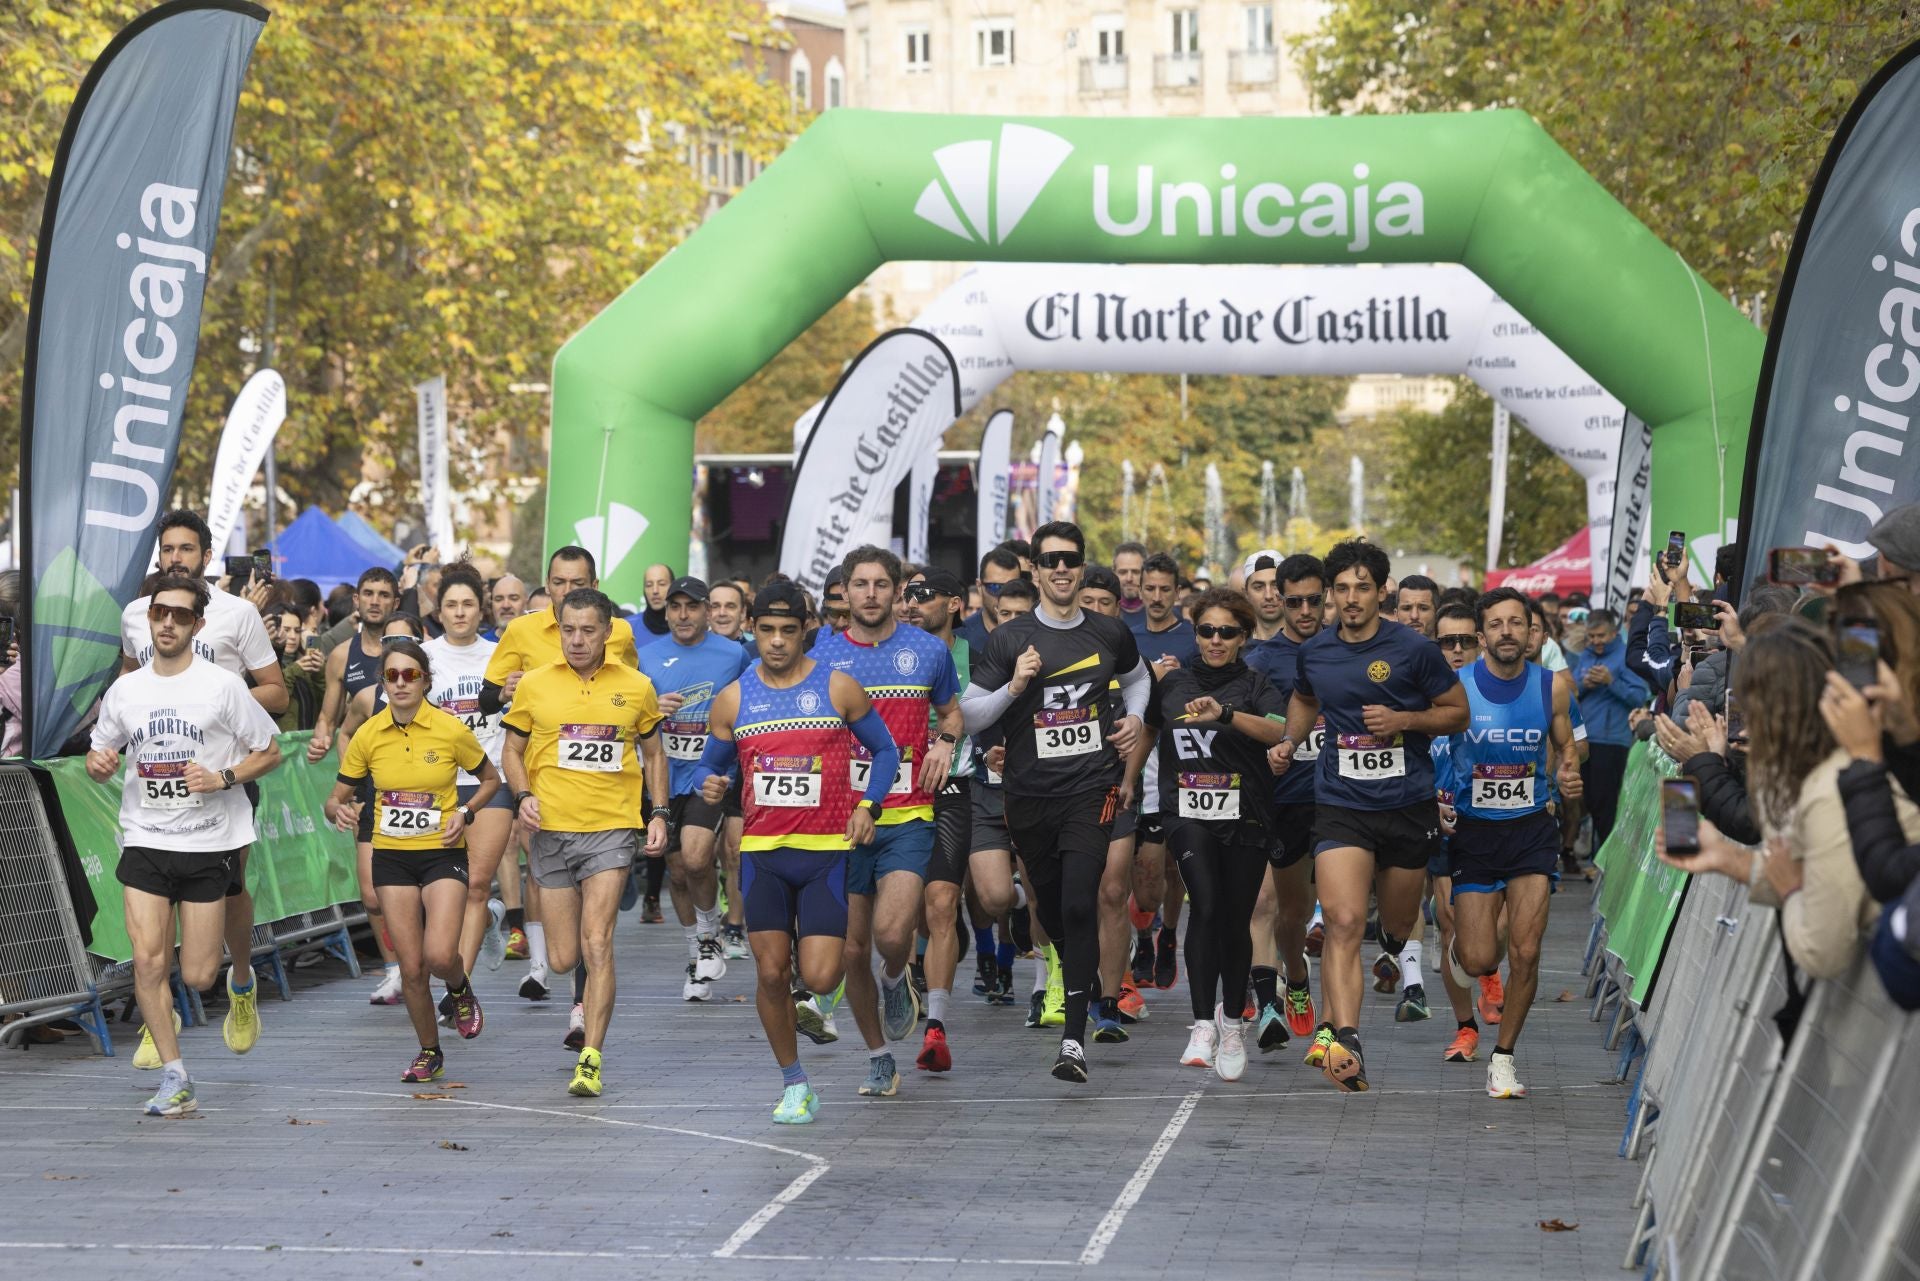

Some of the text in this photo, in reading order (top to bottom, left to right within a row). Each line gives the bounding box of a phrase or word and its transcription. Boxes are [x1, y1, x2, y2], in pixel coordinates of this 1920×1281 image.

[1093, 163, 1425, 252] Unicaja
[1026, 293, 1451, 344] El Norte de Castilla
[1493, 323, 1508, 337] El
[85, 182, 207, 532] Unicaja
[1475, 357, 1516, 369] Castilla
[1515, 387, 1544, 400] Norte
[1558, 385, 1603, 398] Castilla
[244, 379, 282, 455] Castilla
[830, 476, 868, 513] de
[855, 354, 949, 475] Castilla
[989, 474, 1008, 547] icaja
[1615, 493, 1643, 582] Norte
[1632, 456, 1650, 490] de
[1043, 683, 1093, 709] EY
[150, 708, 177, 719] HOSPITAL
[457, 714, 488, 730] 44
[149, 717, 205, 746] HORTEGA
[1045, 725, 1092, 748] 309
[1304, 732, 1325, 752] 16
[1464, 728, 1542, 743] IVECO
[568, 742, 614, 762] 228
[669, 736, 705, 752] 372
[1172, 728, 1218, 760] EY
[138, 749, 196, 762] UNIVERSITARIO
[1348, 751, 1394, 770] 168
[147, 780, 191, 800] 545
[762, 775, 810, 796] 755
[1482, 780, 1526, 800] 564
[1187, 790, 1230, 811] 307
[388, 808, 430, 829] 226
[83, 849, 105, 882] caja
